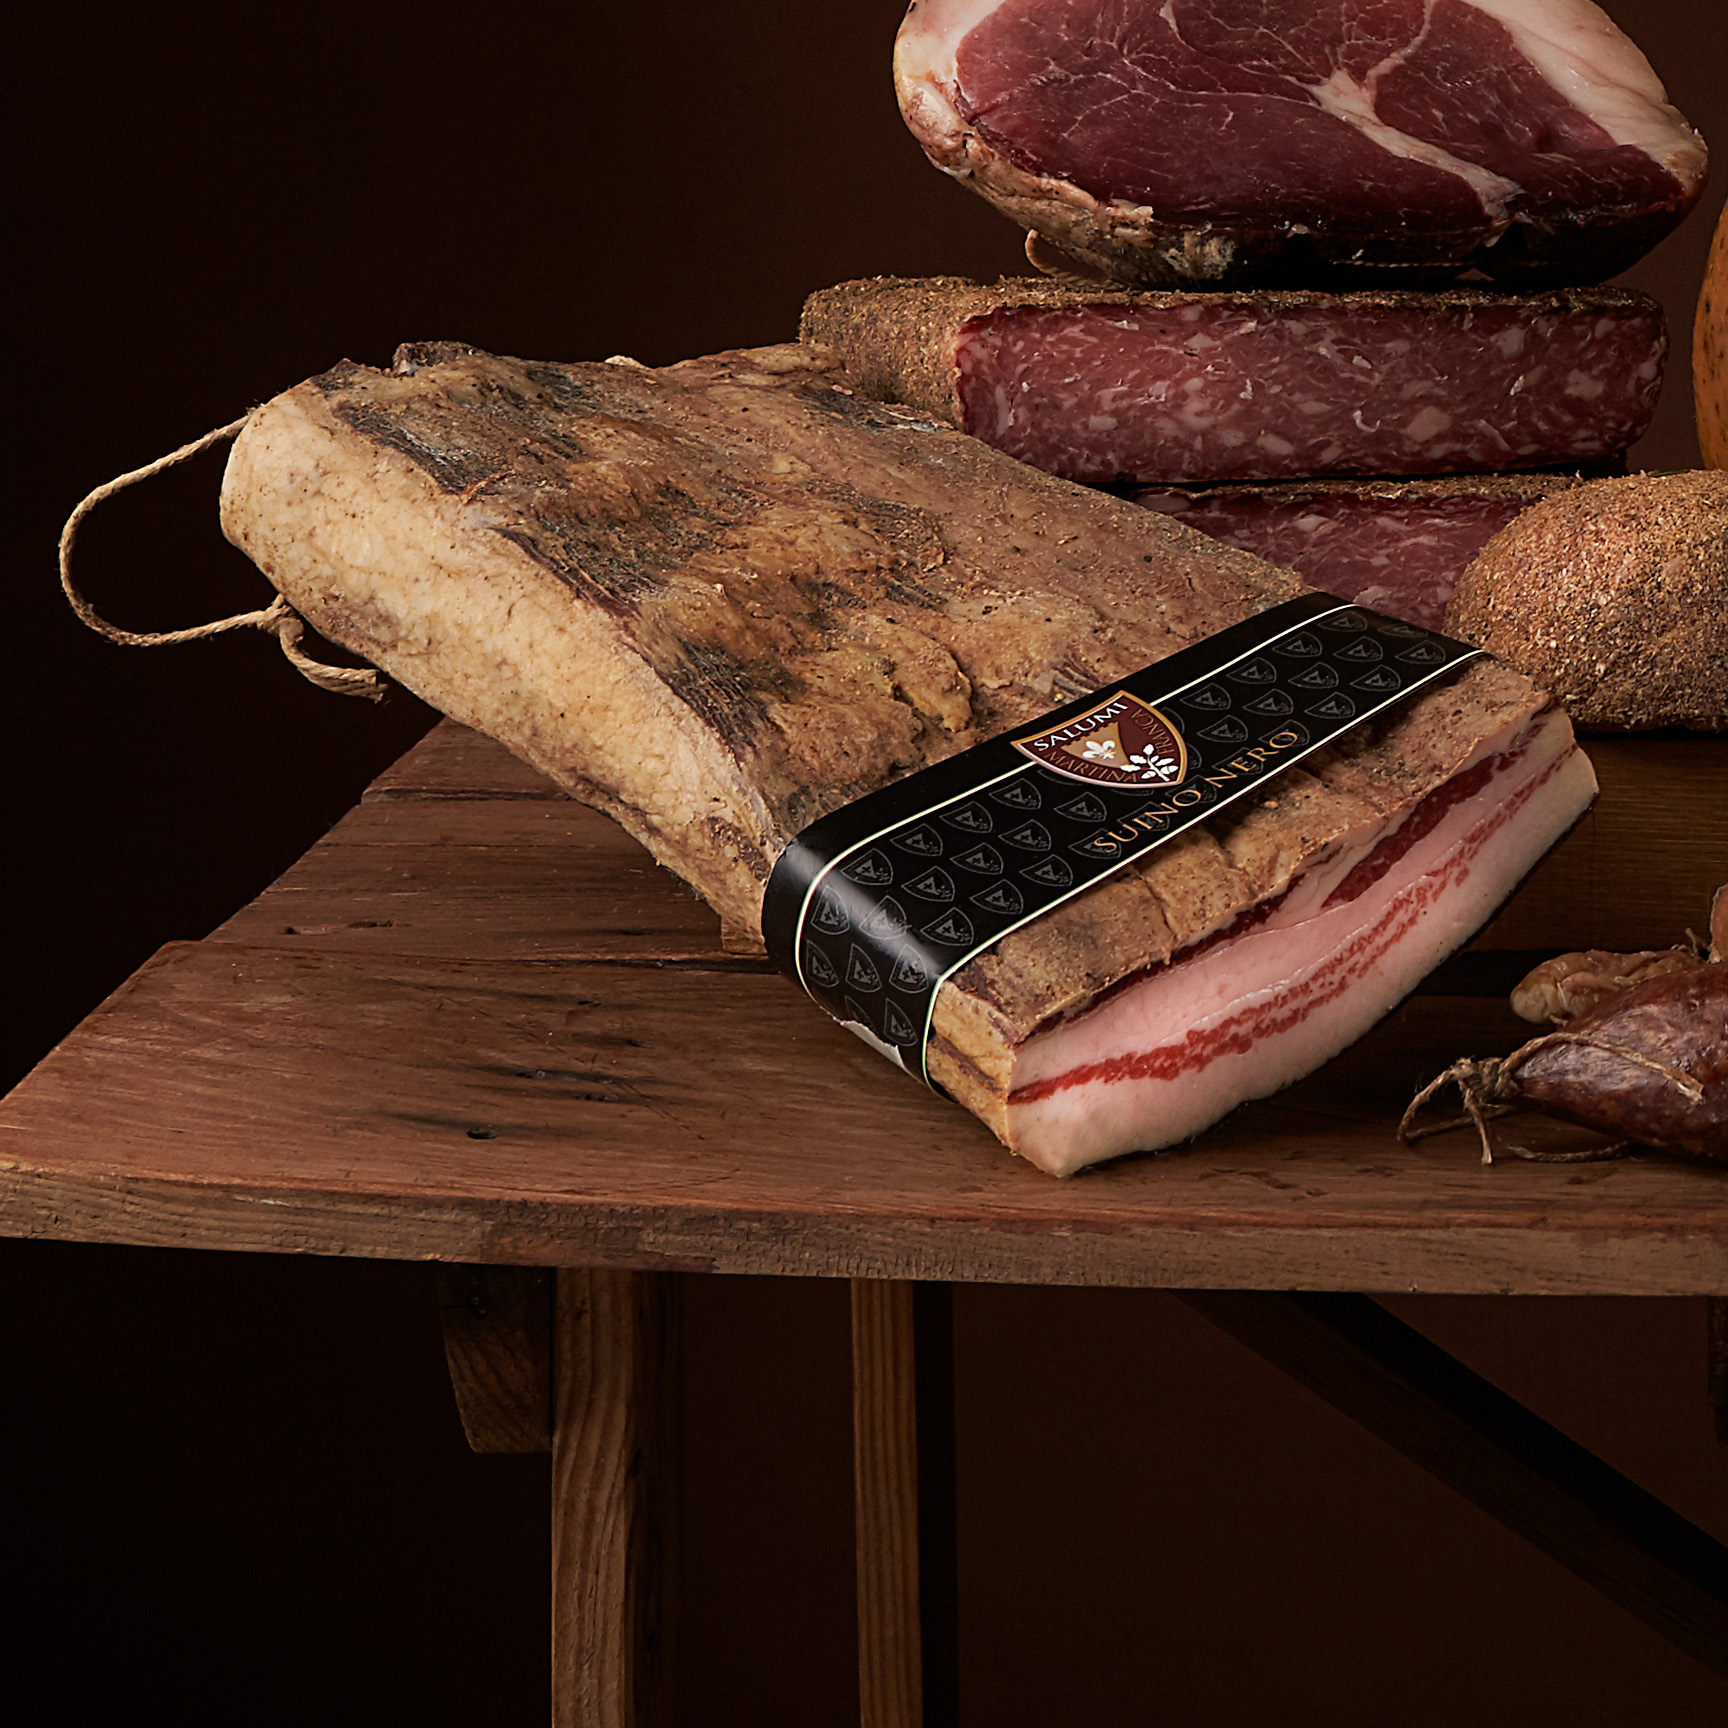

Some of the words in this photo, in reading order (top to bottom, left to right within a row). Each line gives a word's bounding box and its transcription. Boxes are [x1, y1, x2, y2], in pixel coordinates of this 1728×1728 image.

[1033, 702, 1128, 751] SALUMI
[1044, 750, 1138, 783] MARTINA
[1131, 708, 1175, 755] FRANCA
[1094, 789, 1202, 853] SUINO
[1204, 732, 1298, 788] NERO
